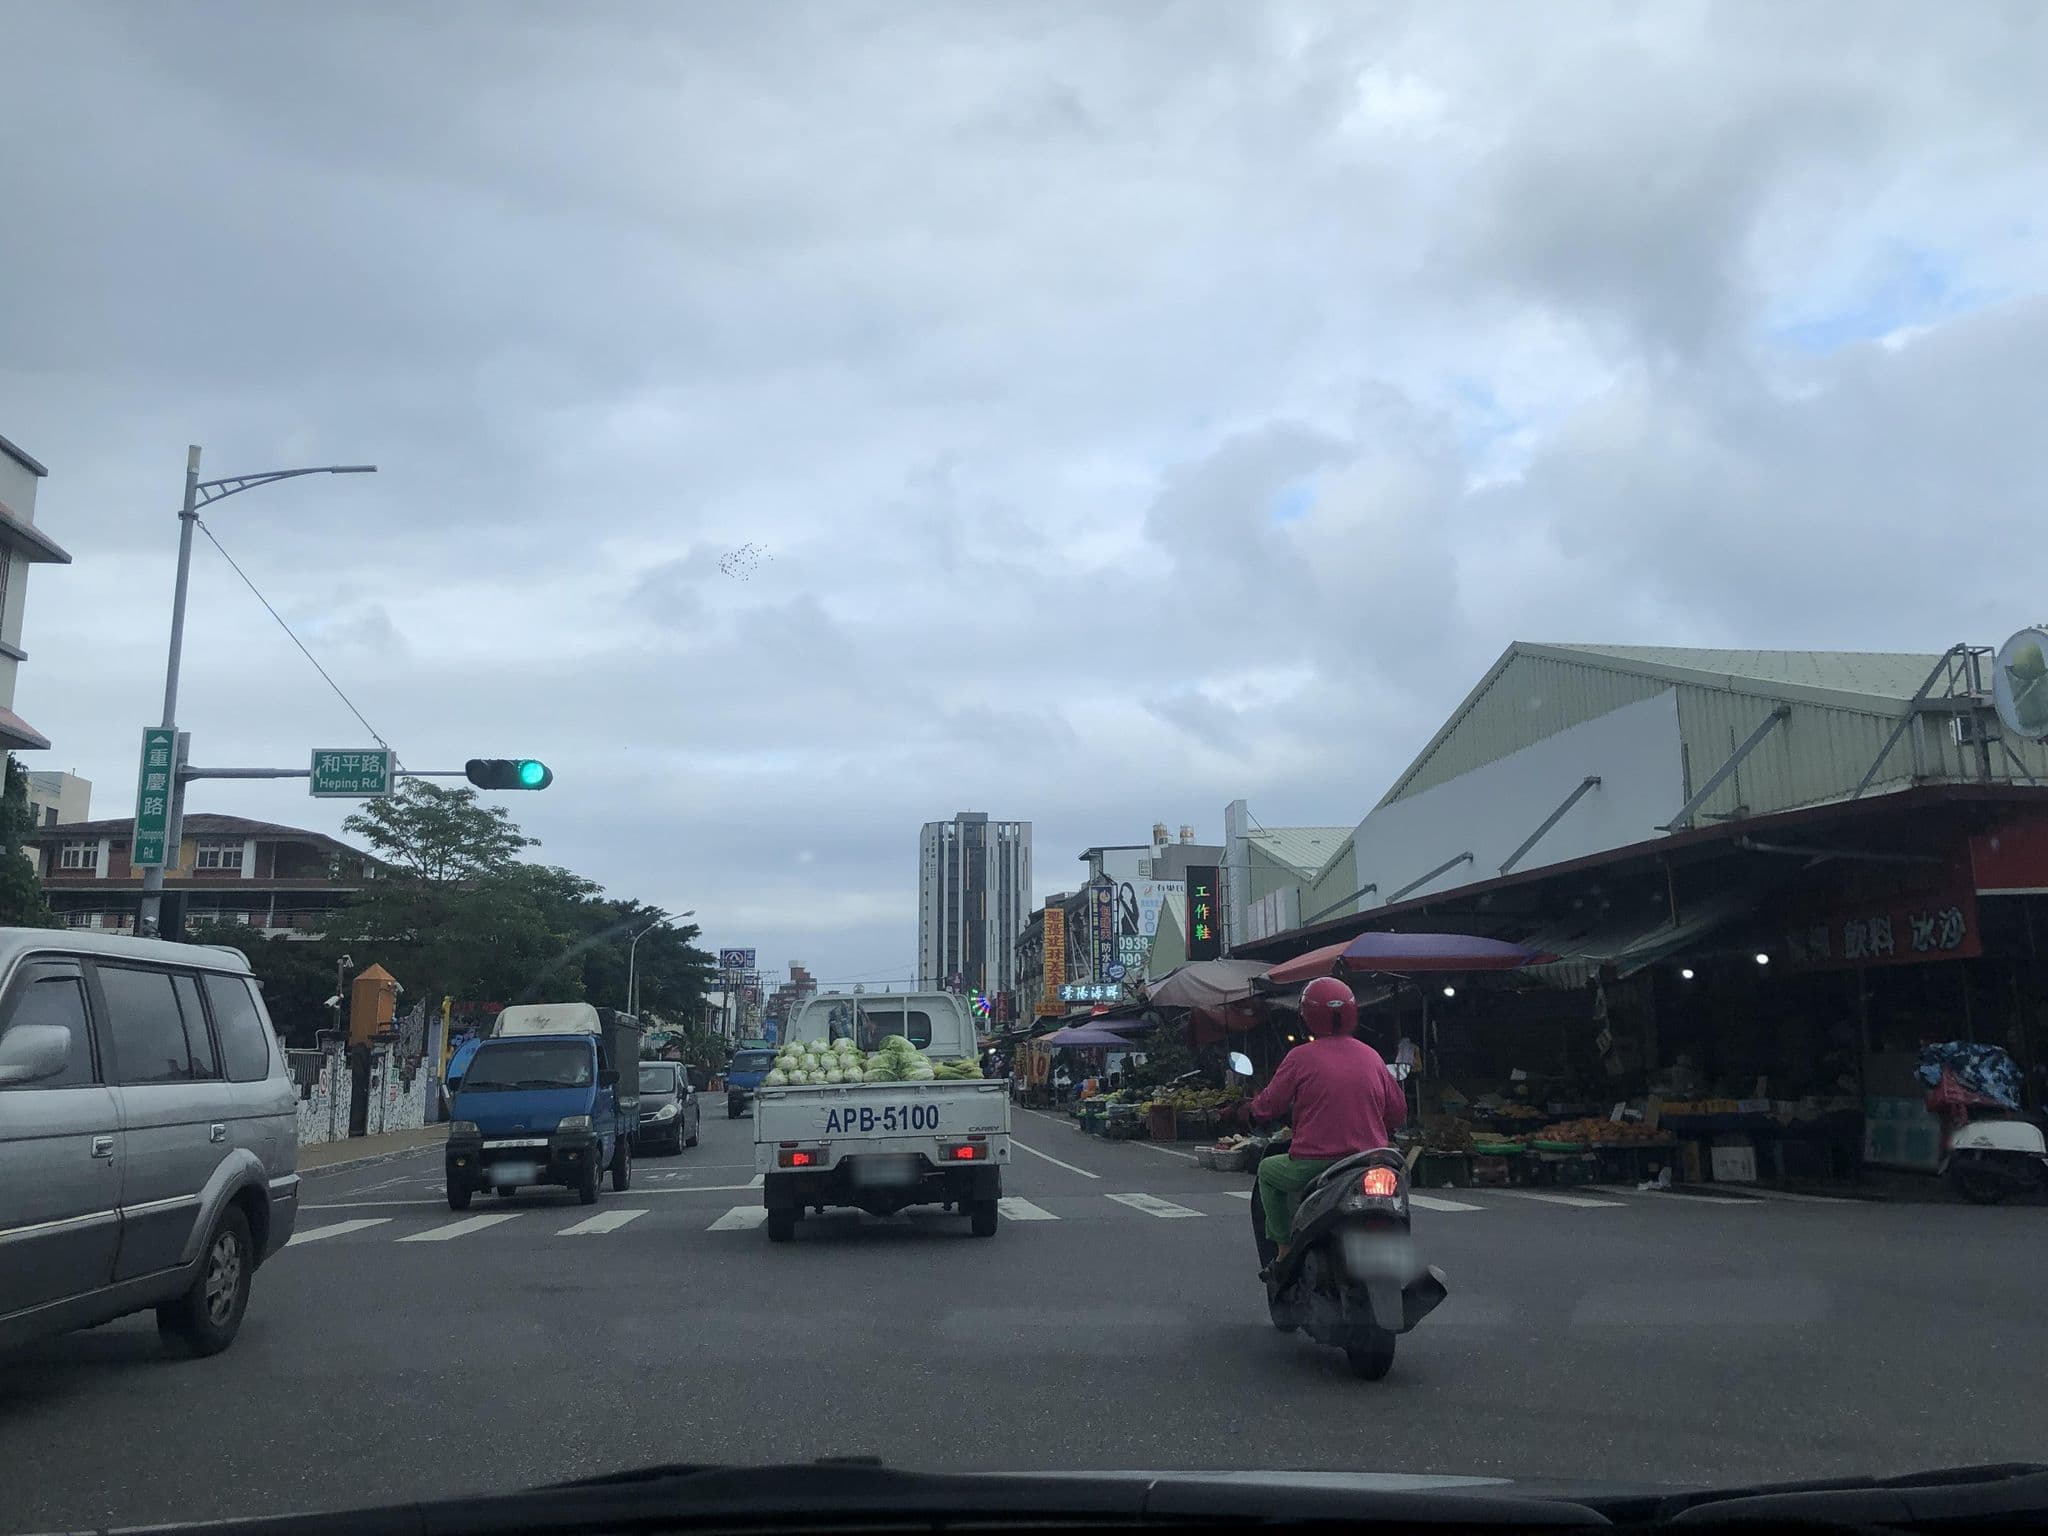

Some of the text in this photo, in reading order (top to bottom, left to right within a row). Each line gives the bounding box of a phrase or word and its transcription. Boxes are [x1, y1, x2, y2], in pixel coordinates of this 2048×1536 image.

[321, 754, 380, 773] 和平路
[143, 748, 169, 816] 重慶路
[319, 777, 380, 791] Heping Rd.
[1194, 886, 1212, 941] 工作鞋
[825, 1104, 939, 1133] APB-5100
